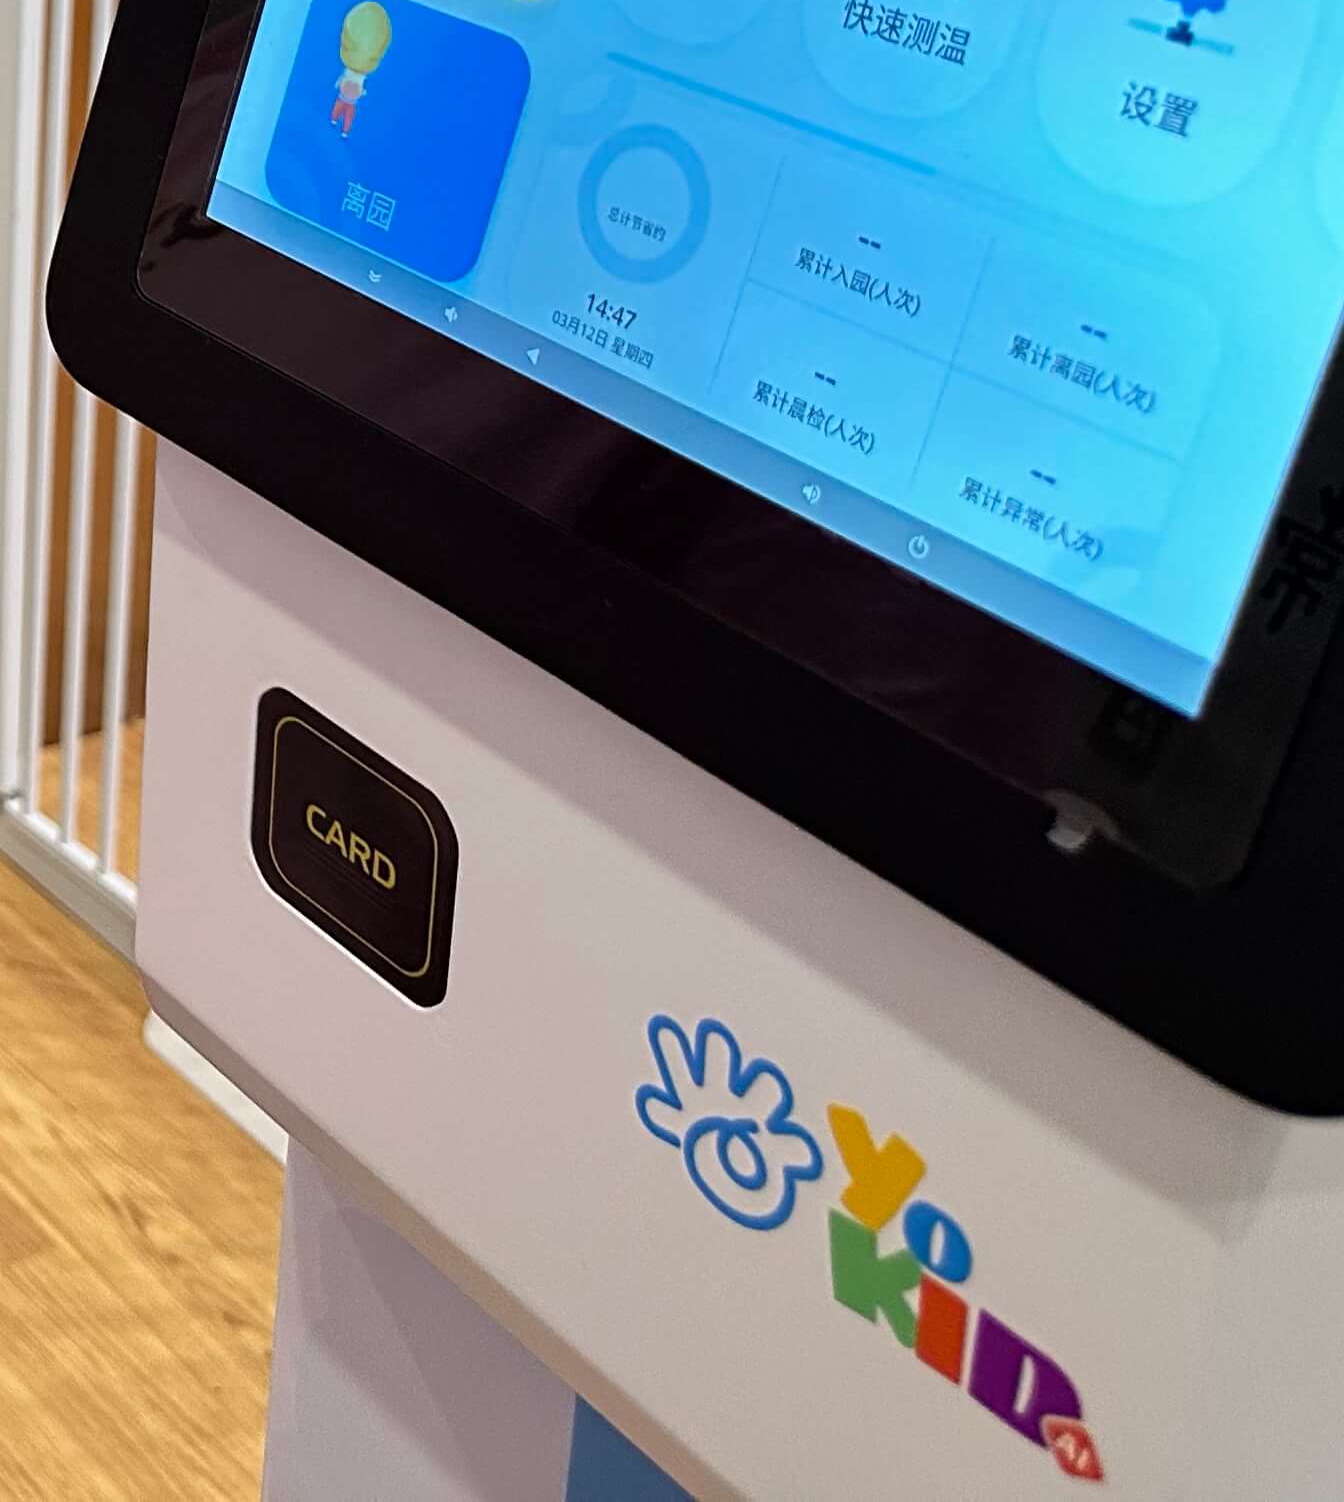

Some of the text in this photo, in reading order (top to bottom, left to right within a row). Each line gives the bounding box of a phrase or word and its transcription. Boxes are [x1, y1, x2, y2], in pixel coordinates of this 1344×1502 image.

[1120, 80, 1198, 138] 设置
[341, 182, 396, 231] 离园
[586, 293, 637, 330] 14:47
[795, 247, 920, 317] 累计入园(人次)
[552, 309, 654, 370] 03月12日 星期四
[306, 804, 396, 889] CARD
